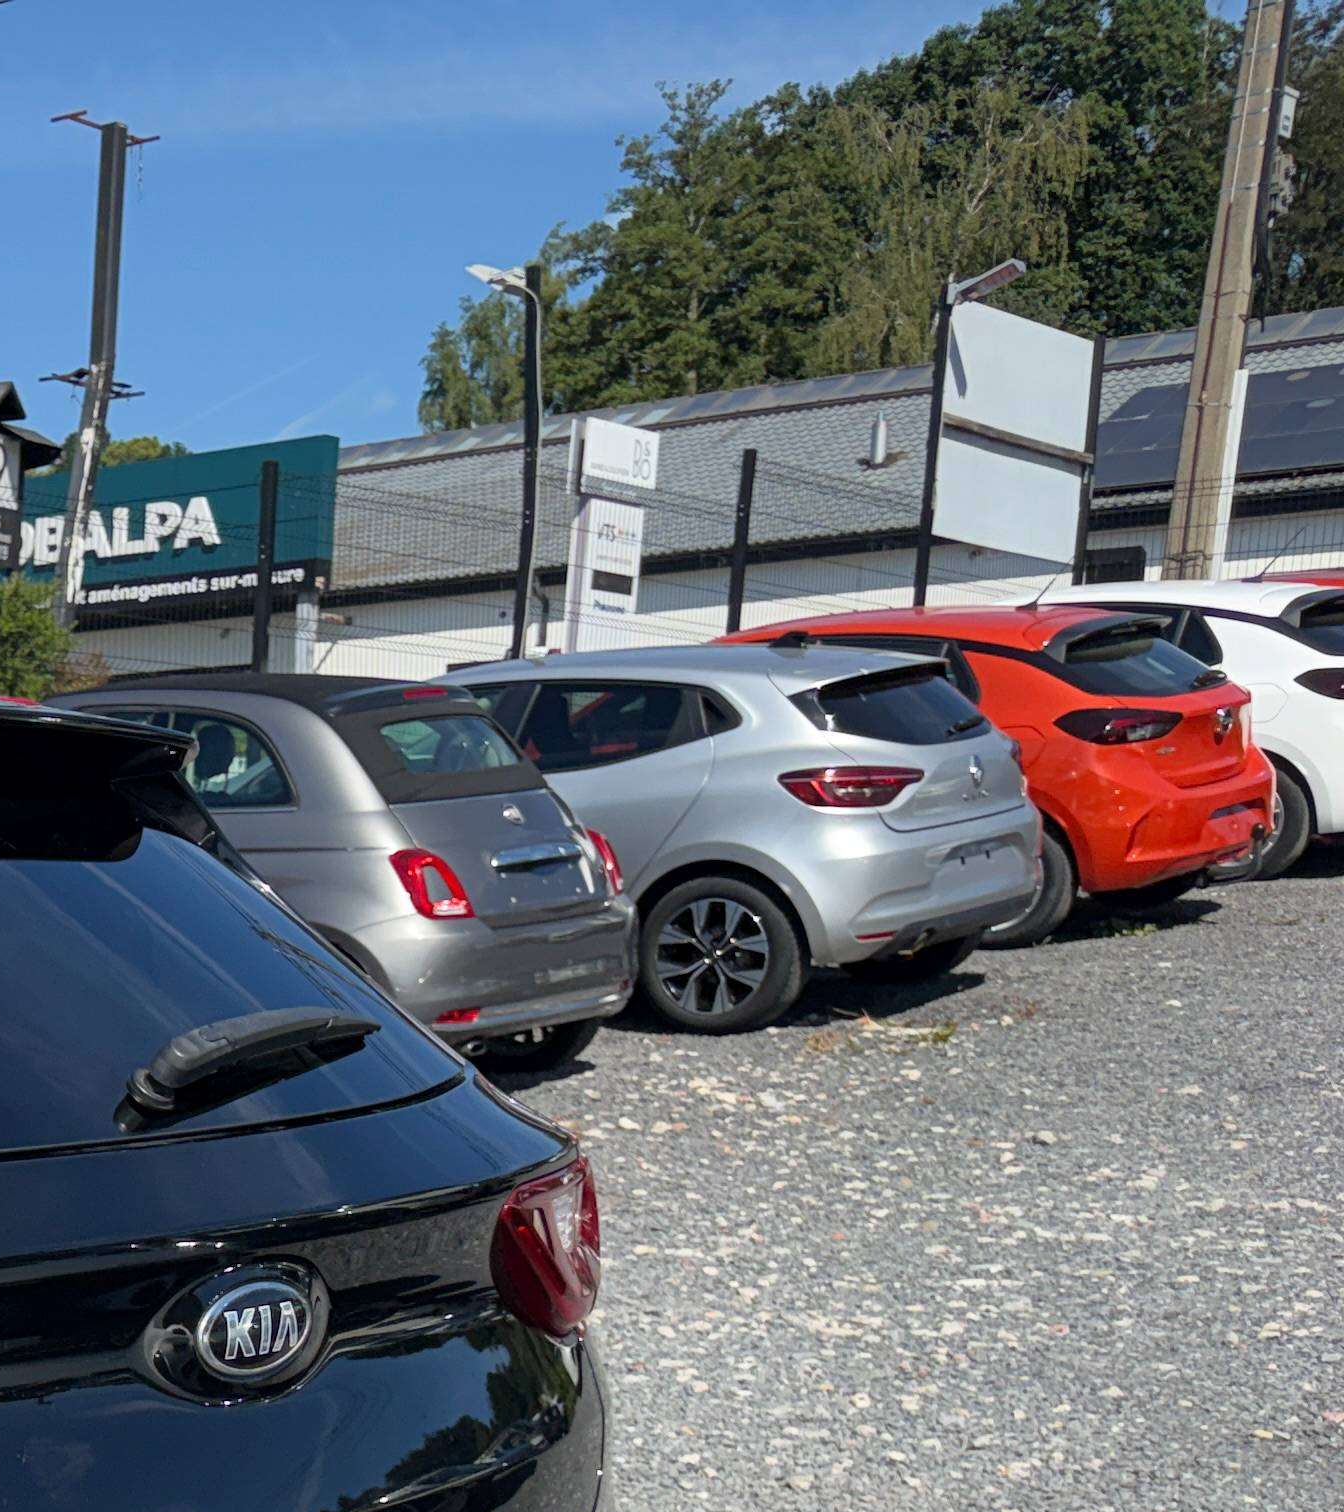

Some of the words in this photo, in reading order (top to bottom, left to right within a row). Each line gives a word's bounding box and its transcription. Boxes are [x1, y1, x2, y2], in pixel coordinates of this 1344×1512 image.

[87, 576, 208, 603] aménagements
[209, 567, 306, 592] sur-msure
[223, 1300, 300, 1361] KIA
